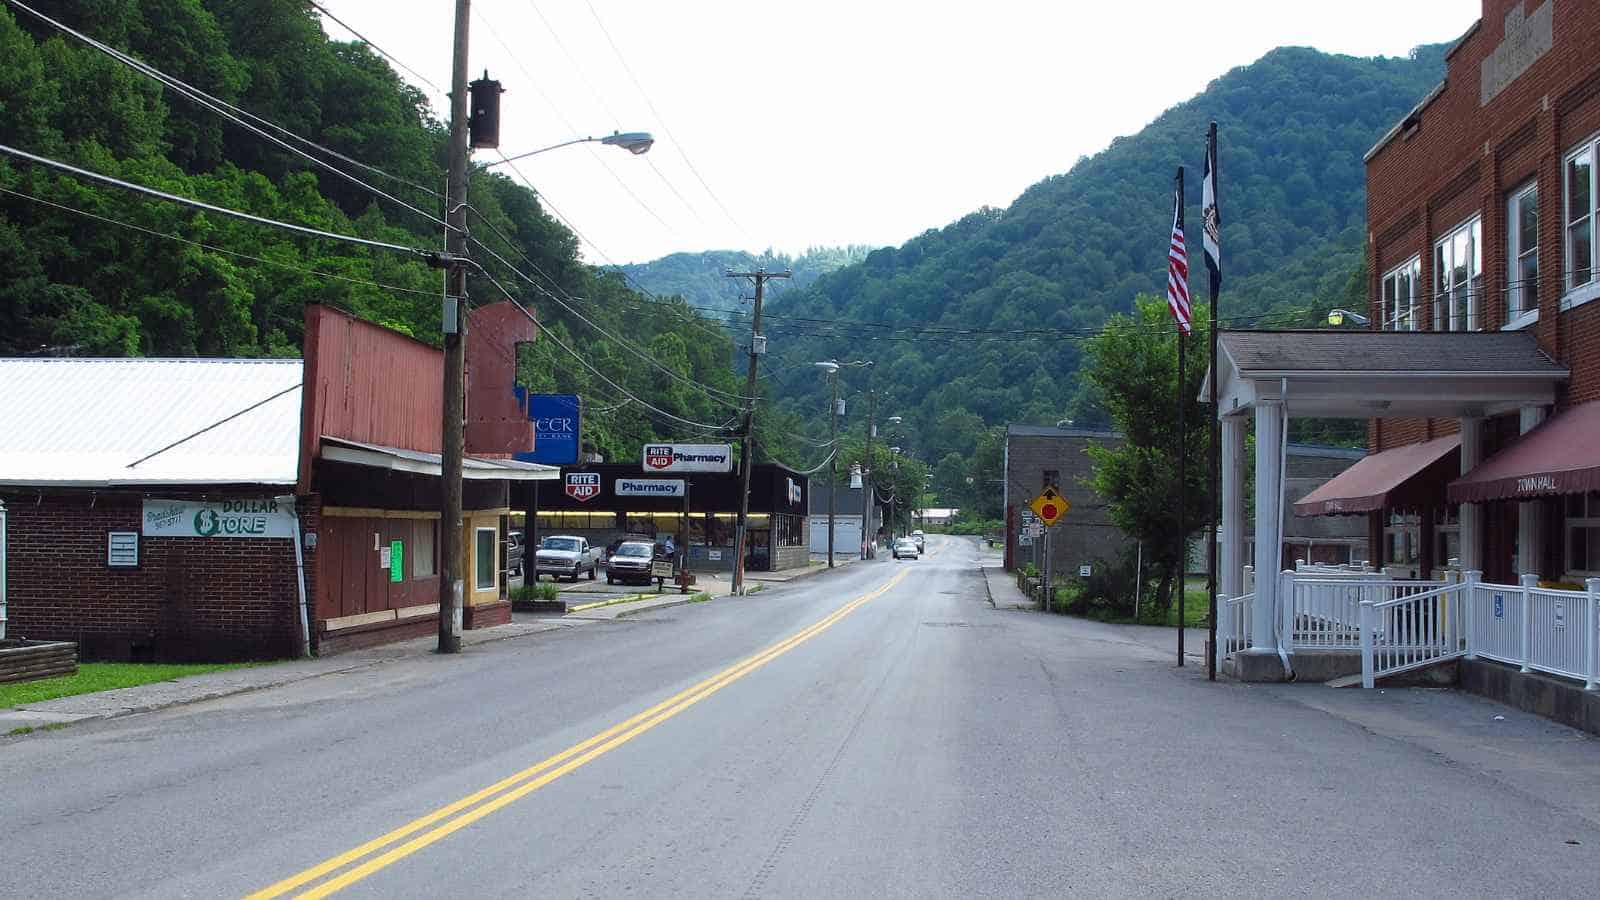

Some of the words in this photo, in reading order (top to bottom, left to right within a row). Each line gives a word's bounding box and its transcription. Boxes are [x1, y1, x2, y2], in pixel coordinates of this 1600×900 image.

[650, 447, 670, 456] RITE
[651, 457, 668, 466] AID
[673, 451, 726, 464] Pharmacy
[570, 475, 595, 484] RITE
[1517, 477, 1537, 491] TOWN
[1537, 475, 1557, 490] HALL
[574, 486, 593, 496] AID
[622, 482, 678, 494] Pharmacy
[223, 500, 279, 513] DOLLAR
